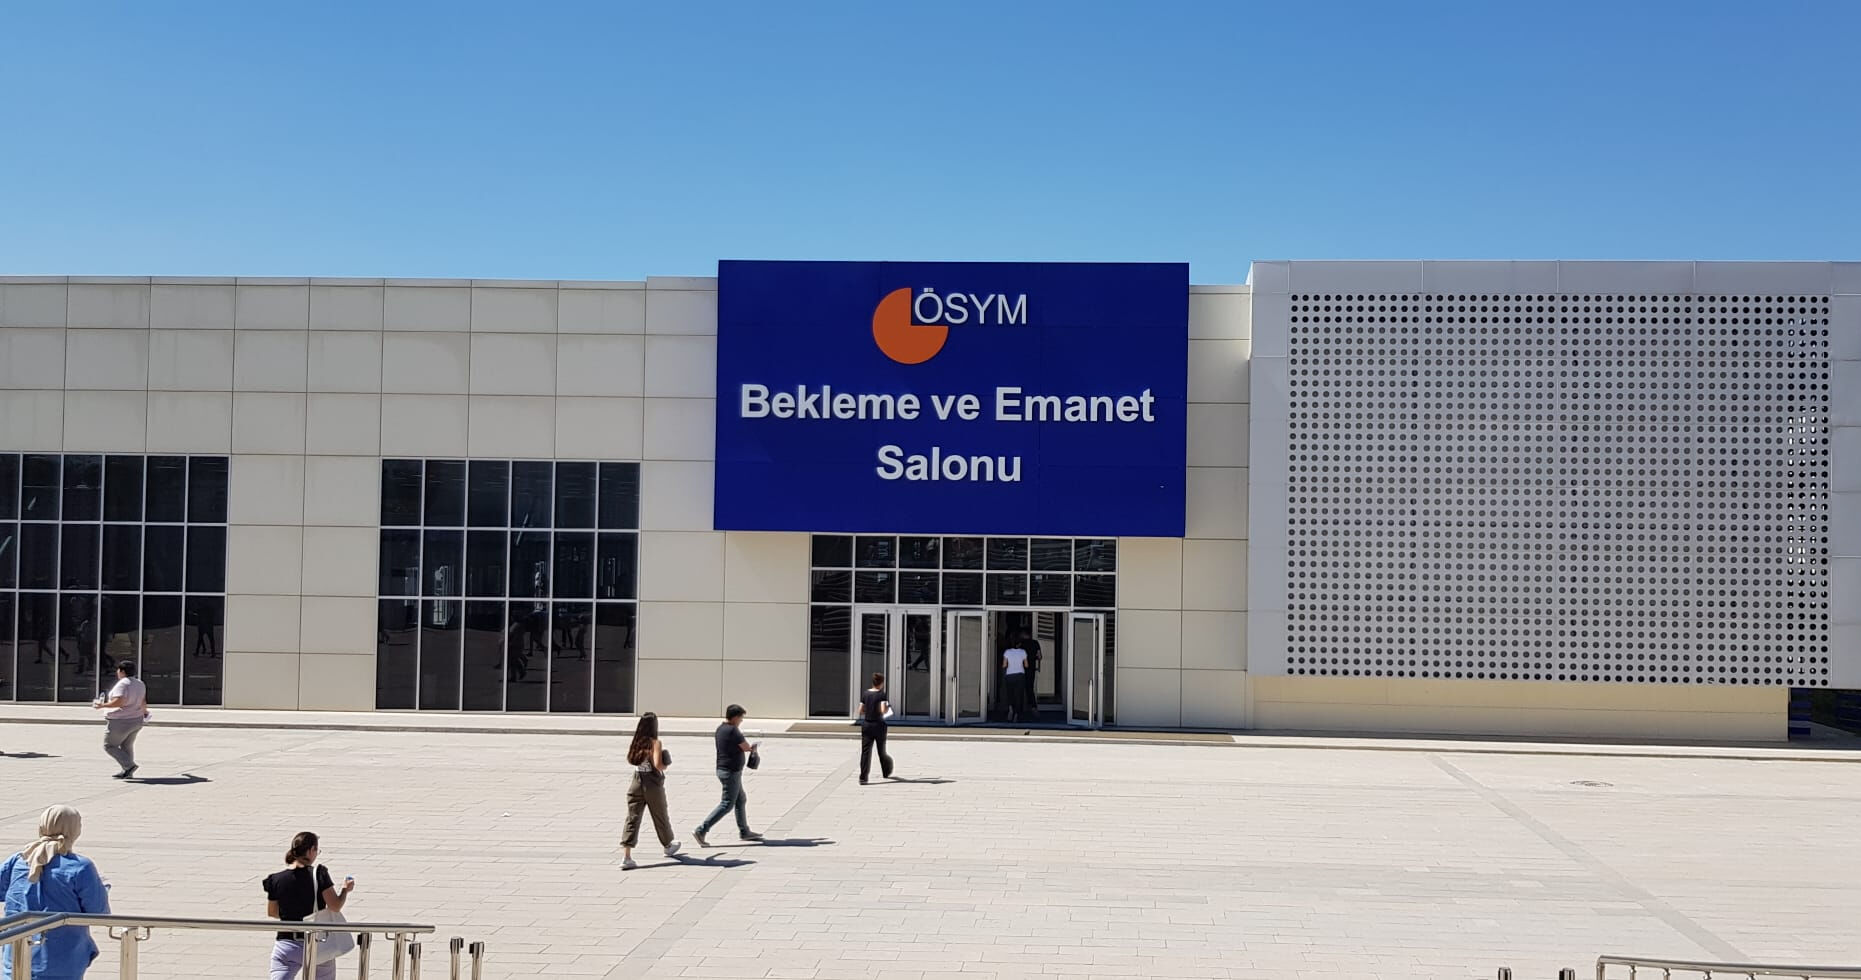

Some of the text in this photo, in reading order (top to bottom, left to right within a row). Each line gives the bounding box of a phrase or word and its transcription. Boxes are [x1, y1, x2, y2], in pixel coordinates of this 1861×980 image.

[914, 287, 1027, 325] ÖSYM
[741, 383, 1156, 422] Bekleme ve Emanet
[876, 444, 1021, 482] Salonu
